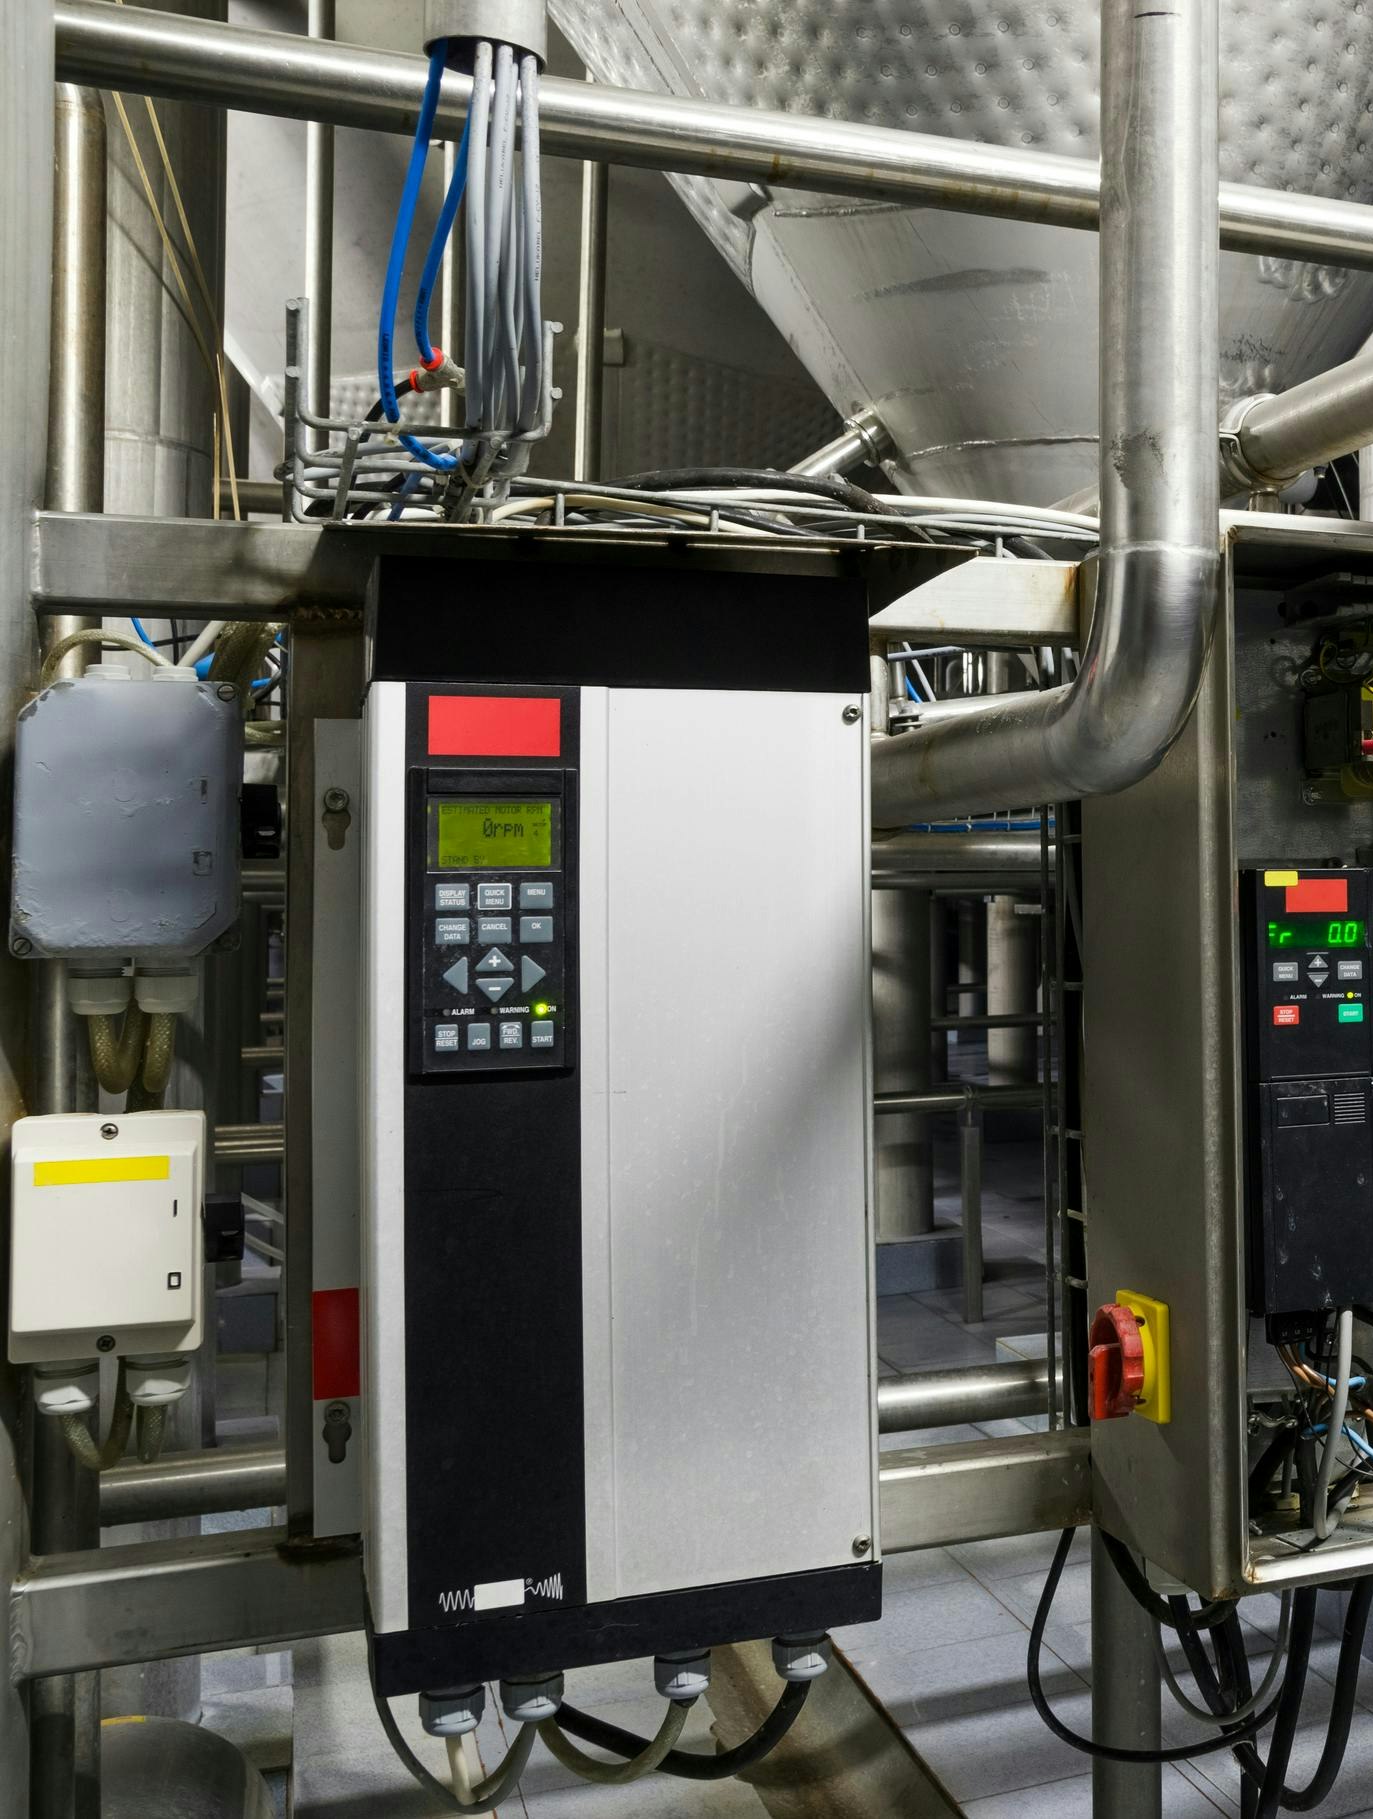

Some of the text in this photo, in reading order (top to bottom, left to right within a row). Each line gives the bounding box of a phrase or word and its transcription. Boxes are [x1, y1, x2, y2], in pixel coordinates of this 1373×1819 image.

[441, 805, 490, 815] ESTIMATED
[495, 805, 521, 815] MOTOR
[441, 855, 469, 865] STAND
[499, 1006, 530, 1014] WARNING
[436, 1039, 458, 1047] RESET
